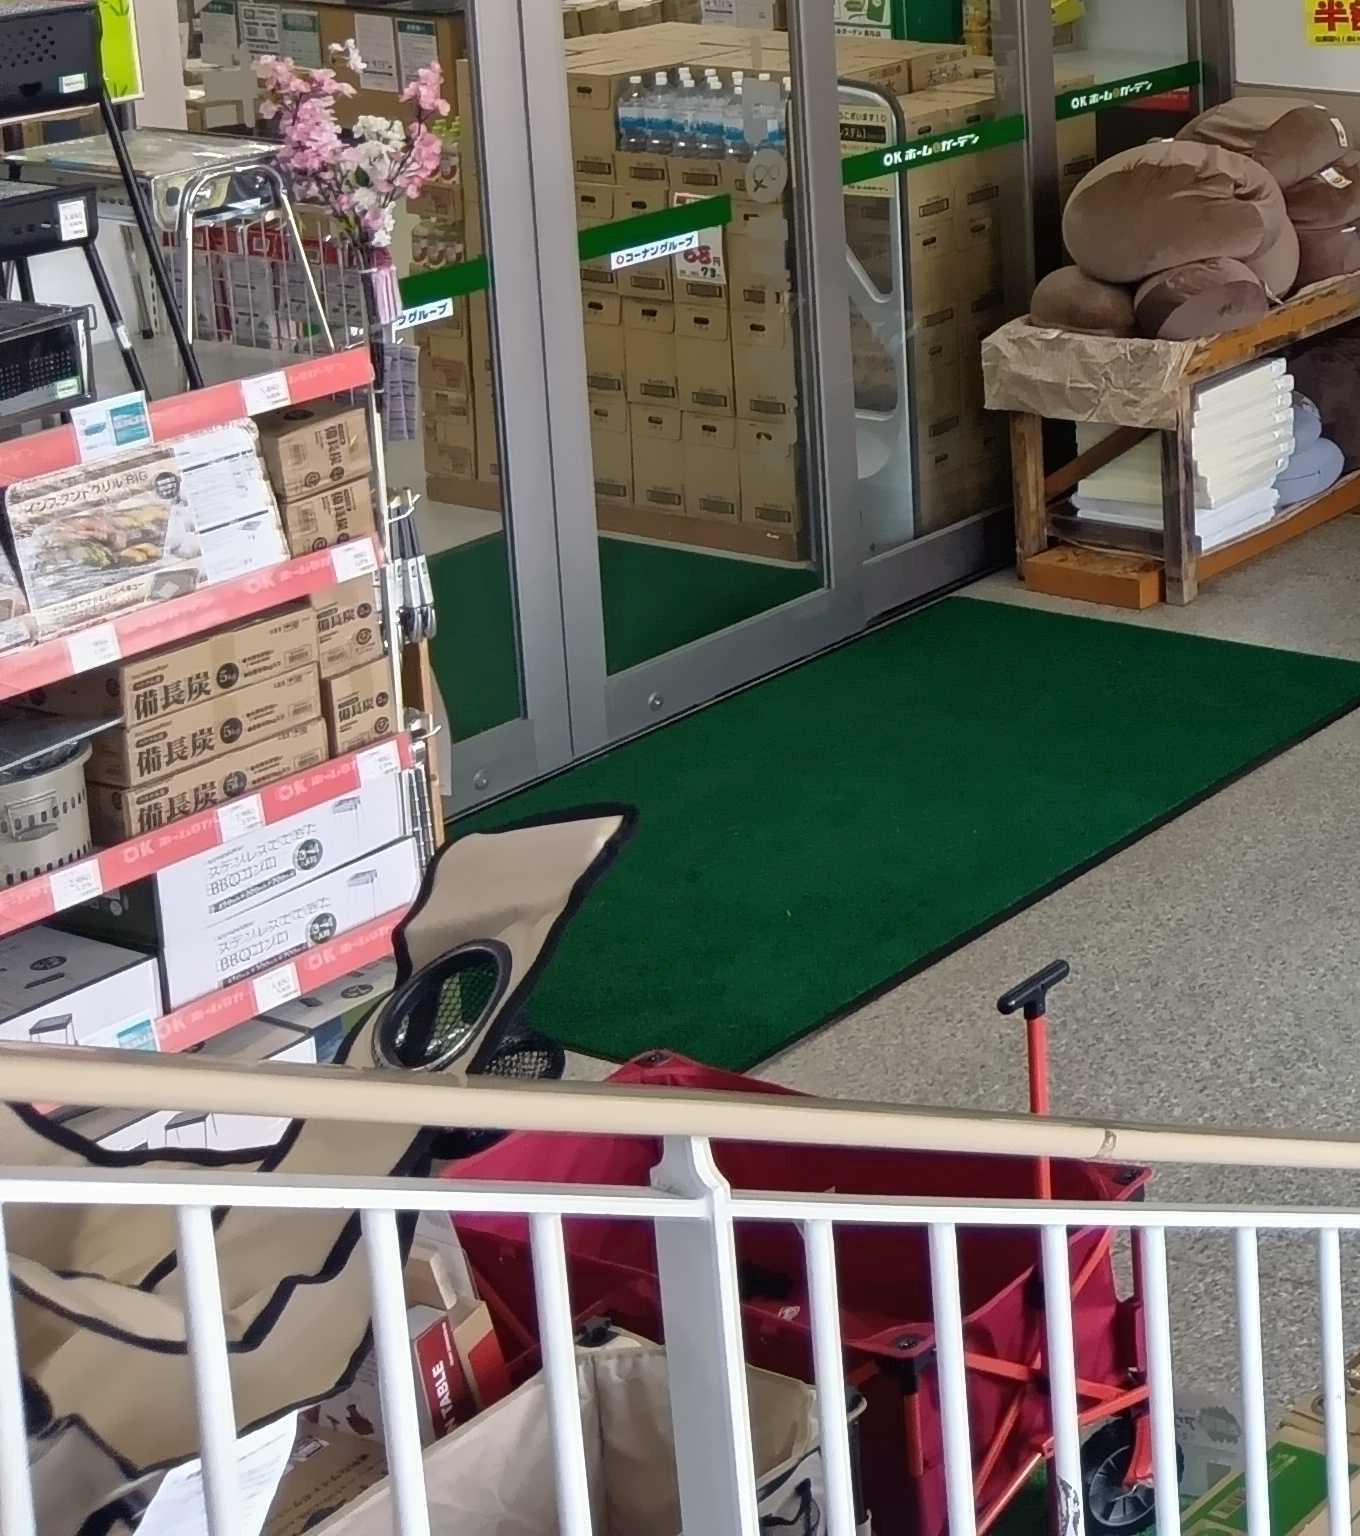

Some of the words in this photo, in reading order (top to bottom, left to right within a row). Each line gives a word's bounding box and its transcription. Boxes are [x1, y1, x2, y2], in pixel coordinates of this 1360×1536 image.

[1070, 95, 1088, 111] OK
[883, 151, 902, 167] OK
[625, 235, 695, 263] コーナングループ
[134, 670, 212, 721] 備長炭
[136, 726, 216, 778] 備長炭
[278, 777, 308, 802] OK
[123, 839, 155, 864] OK
